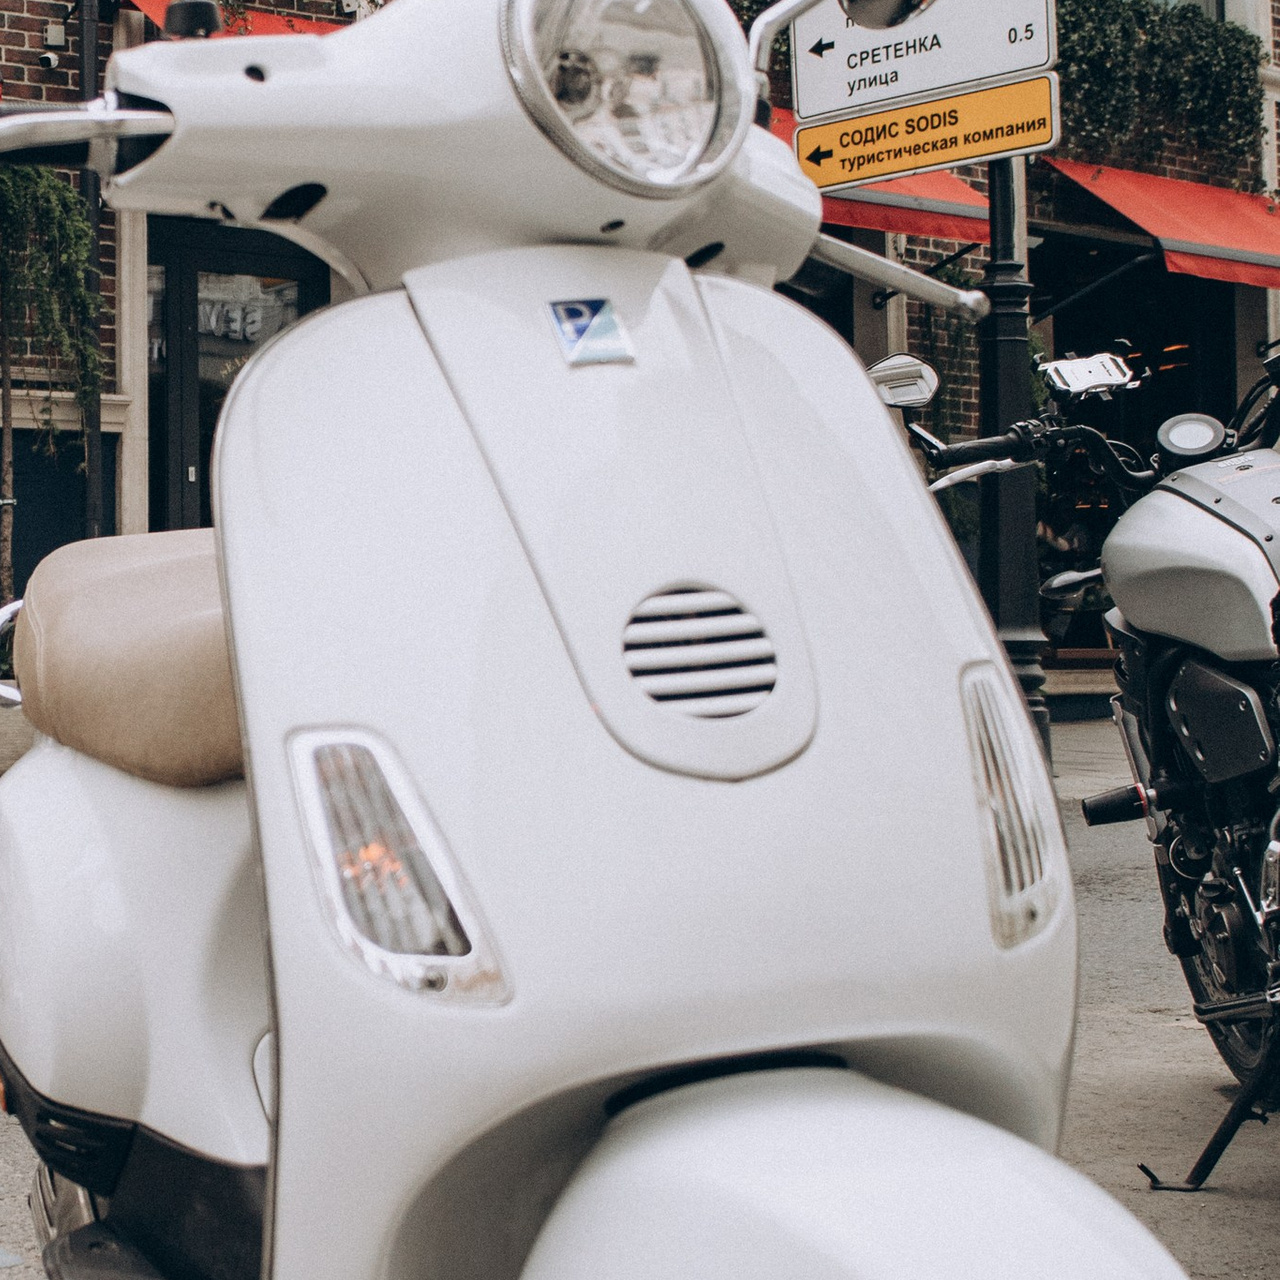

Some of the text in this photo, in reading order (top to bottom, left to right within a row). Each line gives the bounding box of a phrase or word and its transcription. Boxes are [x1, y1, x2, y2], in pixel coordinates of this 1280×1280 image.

[1008, 23, 1034, 44] 0.5
[846, 34, 942, 69] СРЕТЕНКА
[847, 71, 898, 96] улица
[839, 109, 959, 148] СОДИС SODIS
[839, 117, 1046, 172] туристическая компания
